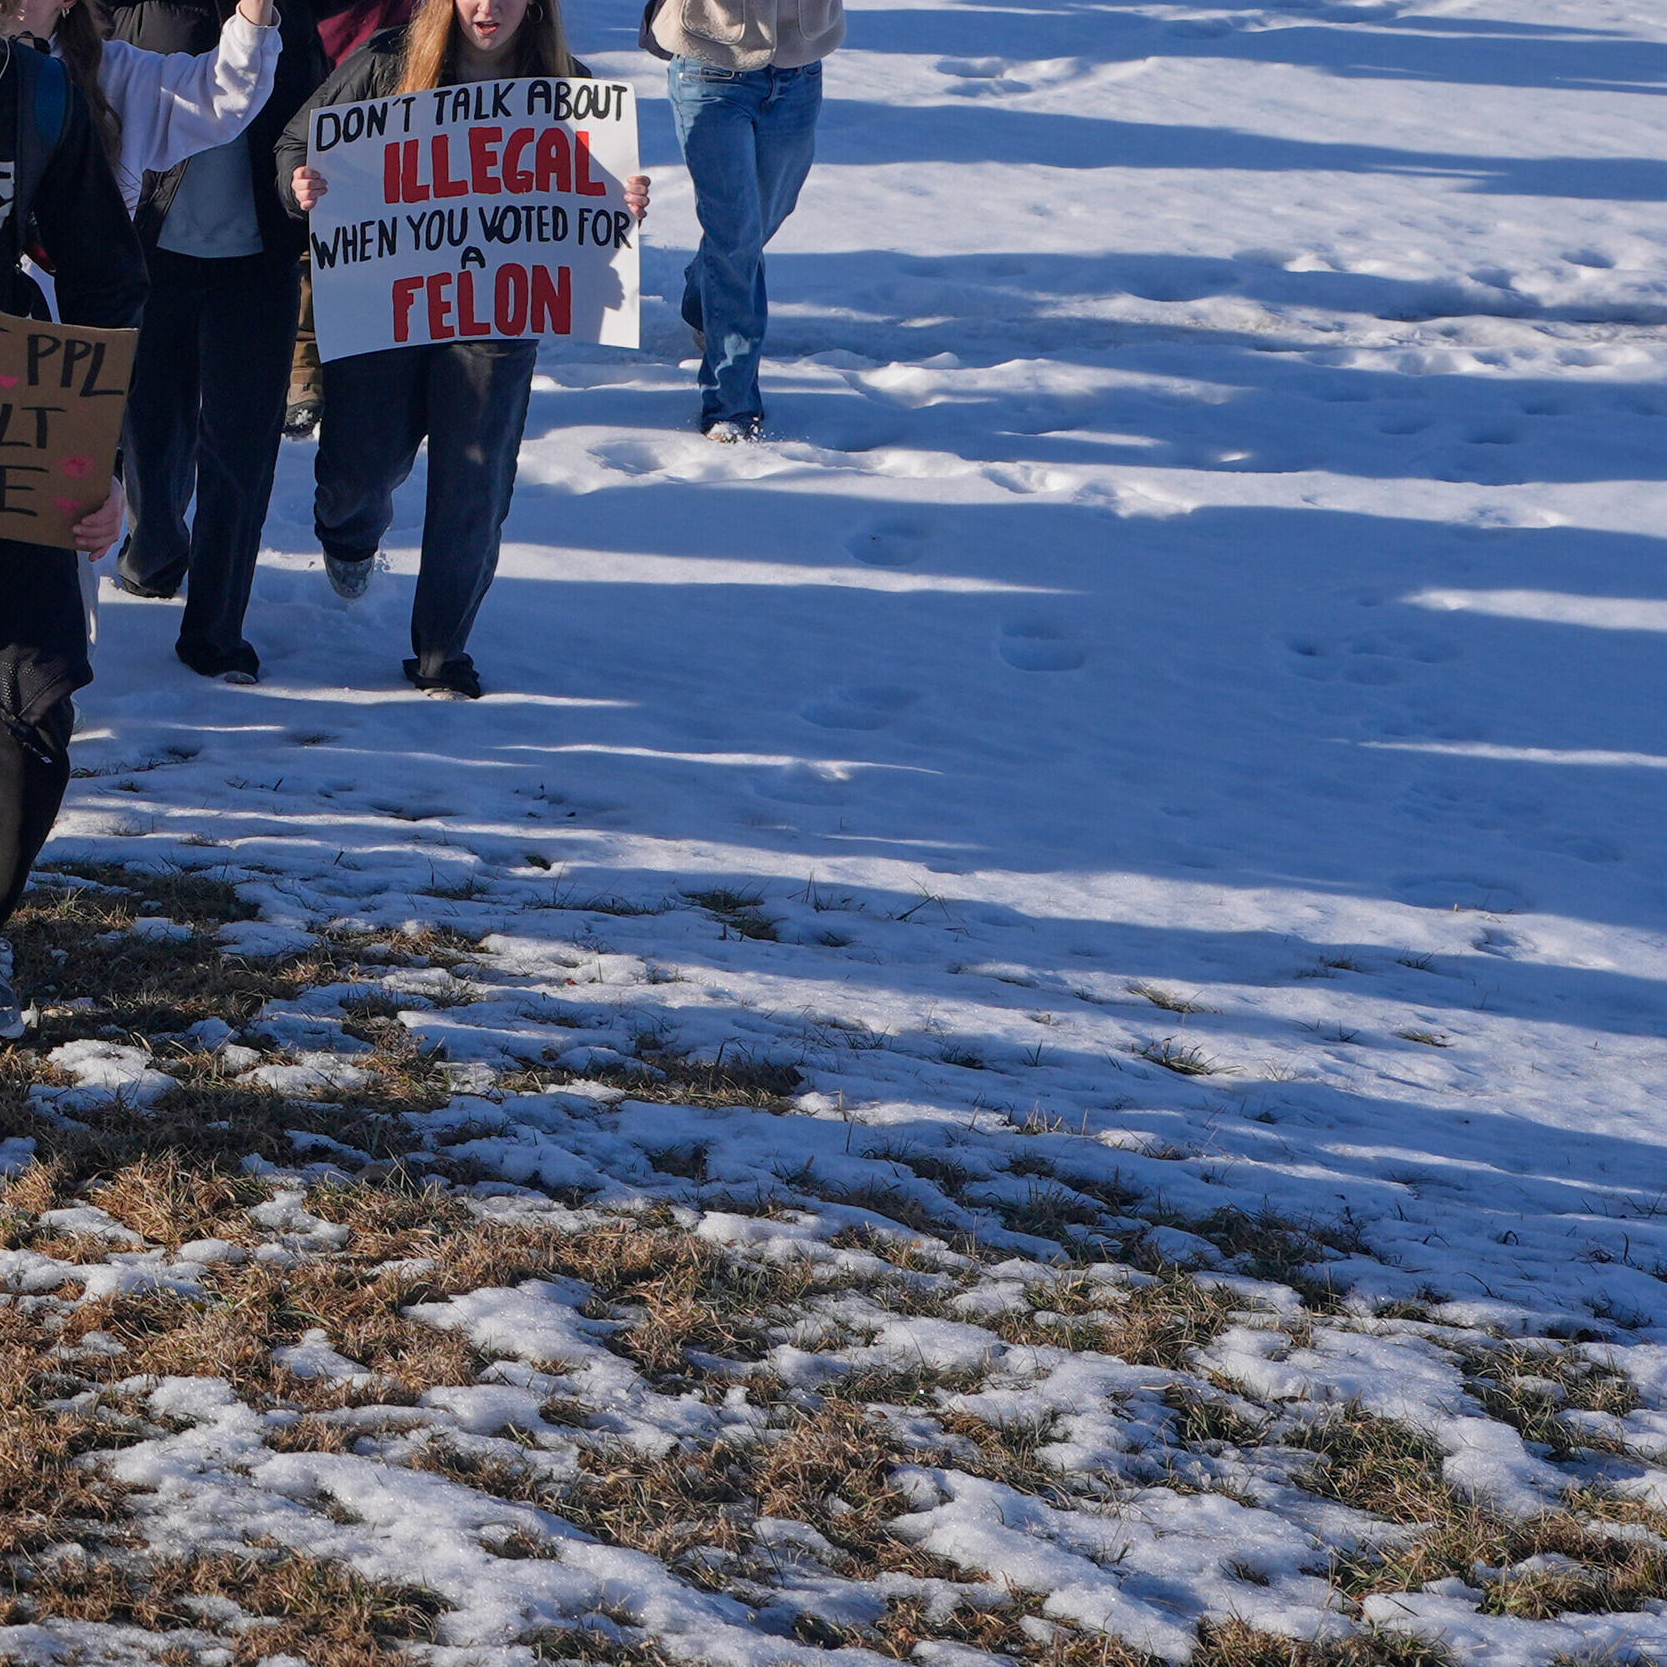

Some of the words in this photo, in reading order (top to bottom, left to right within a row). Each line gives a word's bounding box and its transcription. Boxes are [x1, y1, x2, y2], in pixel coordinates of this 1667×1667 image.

[316, 96, 416, 152] DON'T
[433, 82, 515, 126] TALK
[528, 79, 628, 123] ABOUT
[383, 126, 606, 205] ILLEGAL
[310, 216, 398, 270] WHEN
[406, 207, 467, 252] YOU
[478, 205, 568, 245] VOTED
[577, 208, 632, 250] FOR
[461, 245, 486, 270] A
[392, 263, 572, 343] FELON
[26, 334, 125, 398] PPL
